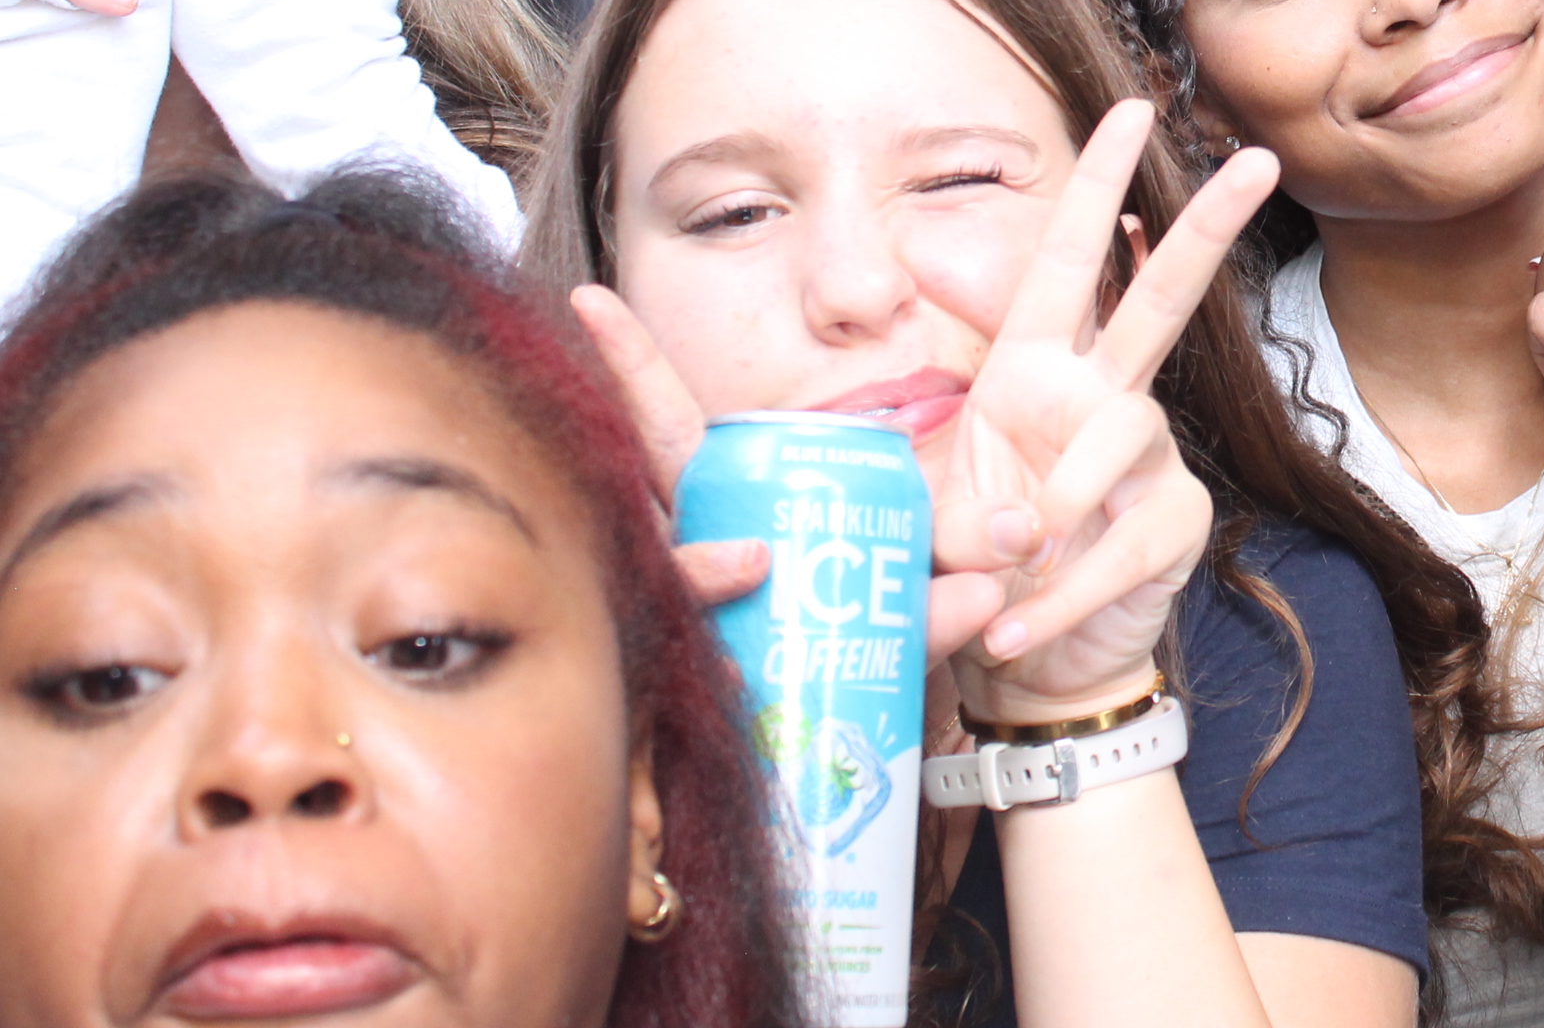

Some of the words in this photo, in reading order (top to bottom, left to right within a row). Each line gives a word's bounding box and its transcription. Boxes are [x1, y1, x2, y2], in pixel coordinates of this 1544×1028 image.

[781, 446, 822, 462] BLUE
[773, 499, 913, 541] SPARKLING
[770, 539, 911, 628] ICE
[763, 637, 904, 685] CFFEINE
[823, 890, 877, 909] SUGAR
